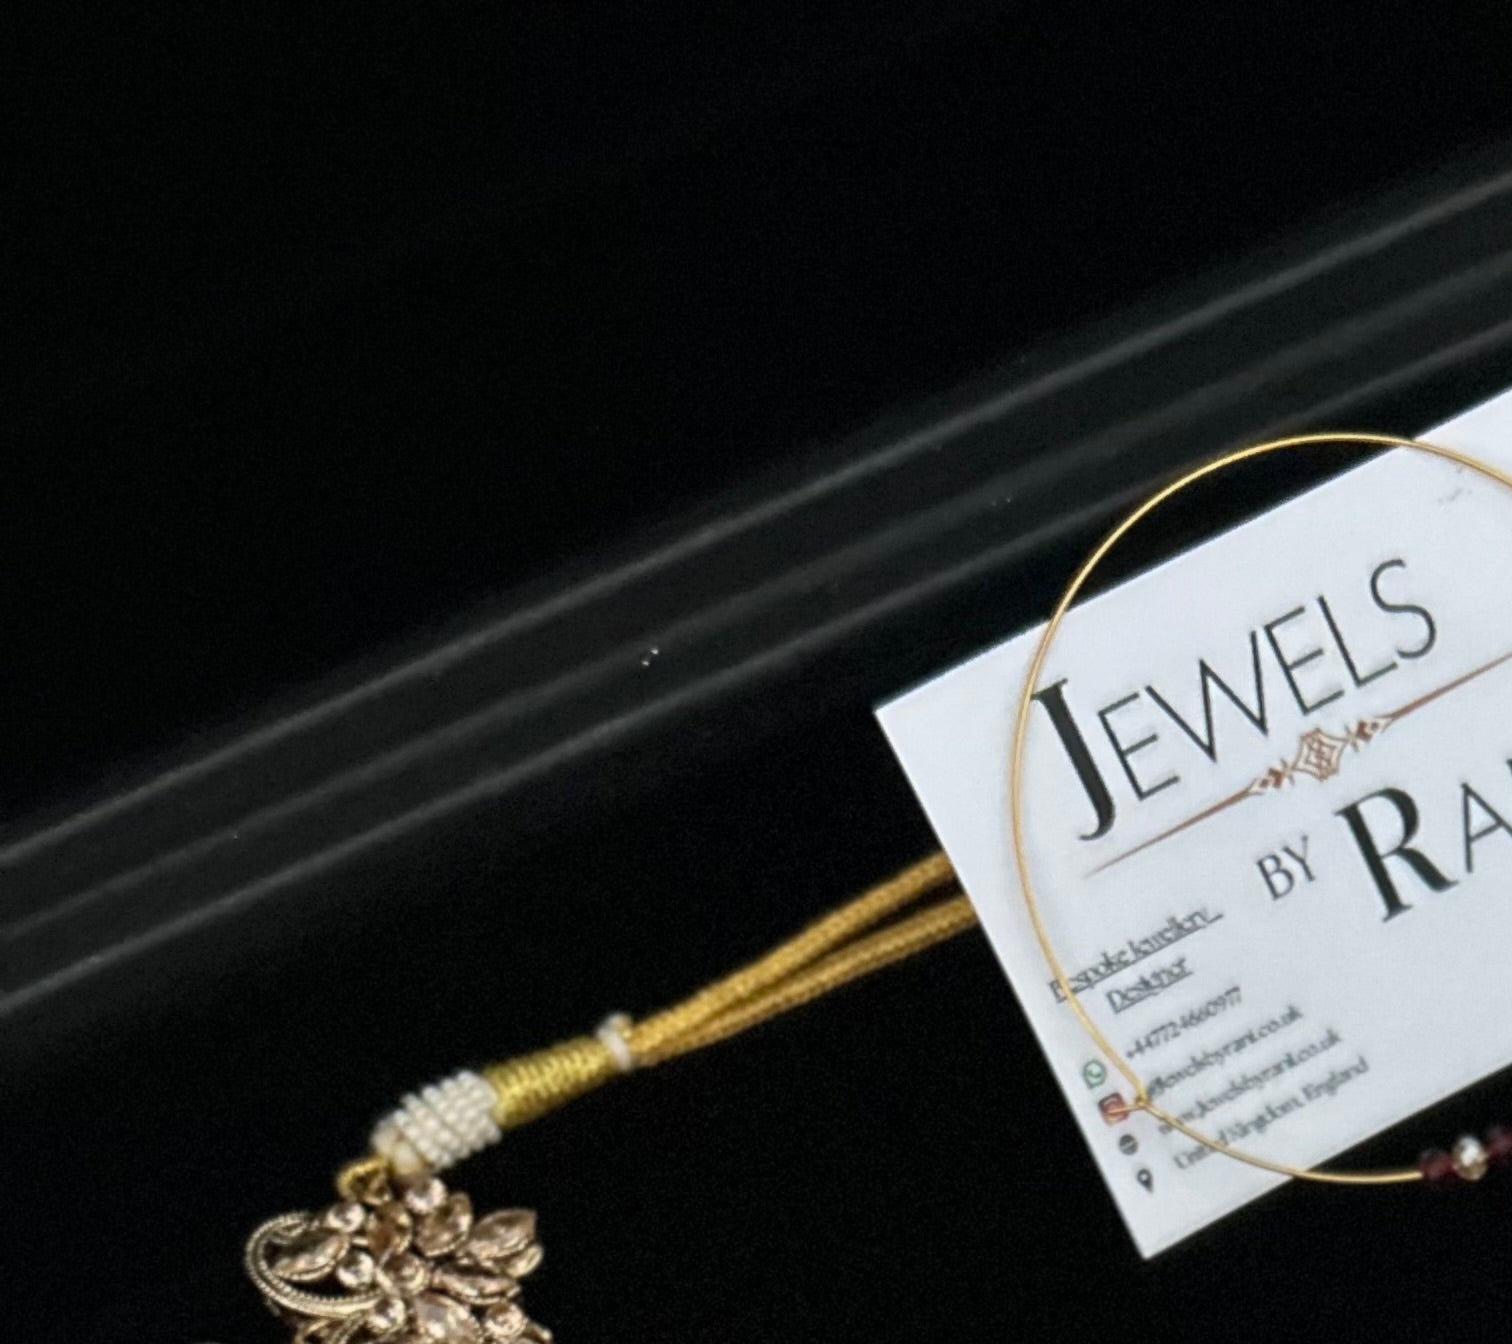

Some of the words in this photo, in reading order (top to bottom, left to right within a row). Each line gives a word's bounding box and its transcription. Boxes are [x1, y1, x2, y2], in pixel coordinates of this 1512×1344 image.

[1031, 558, 1439, 843] JEWELS
[1256, 834, 1318, 901] BY
[1106, 957, 1194, 1015] Designer
[1303, 1056, 1369, 1101] England
